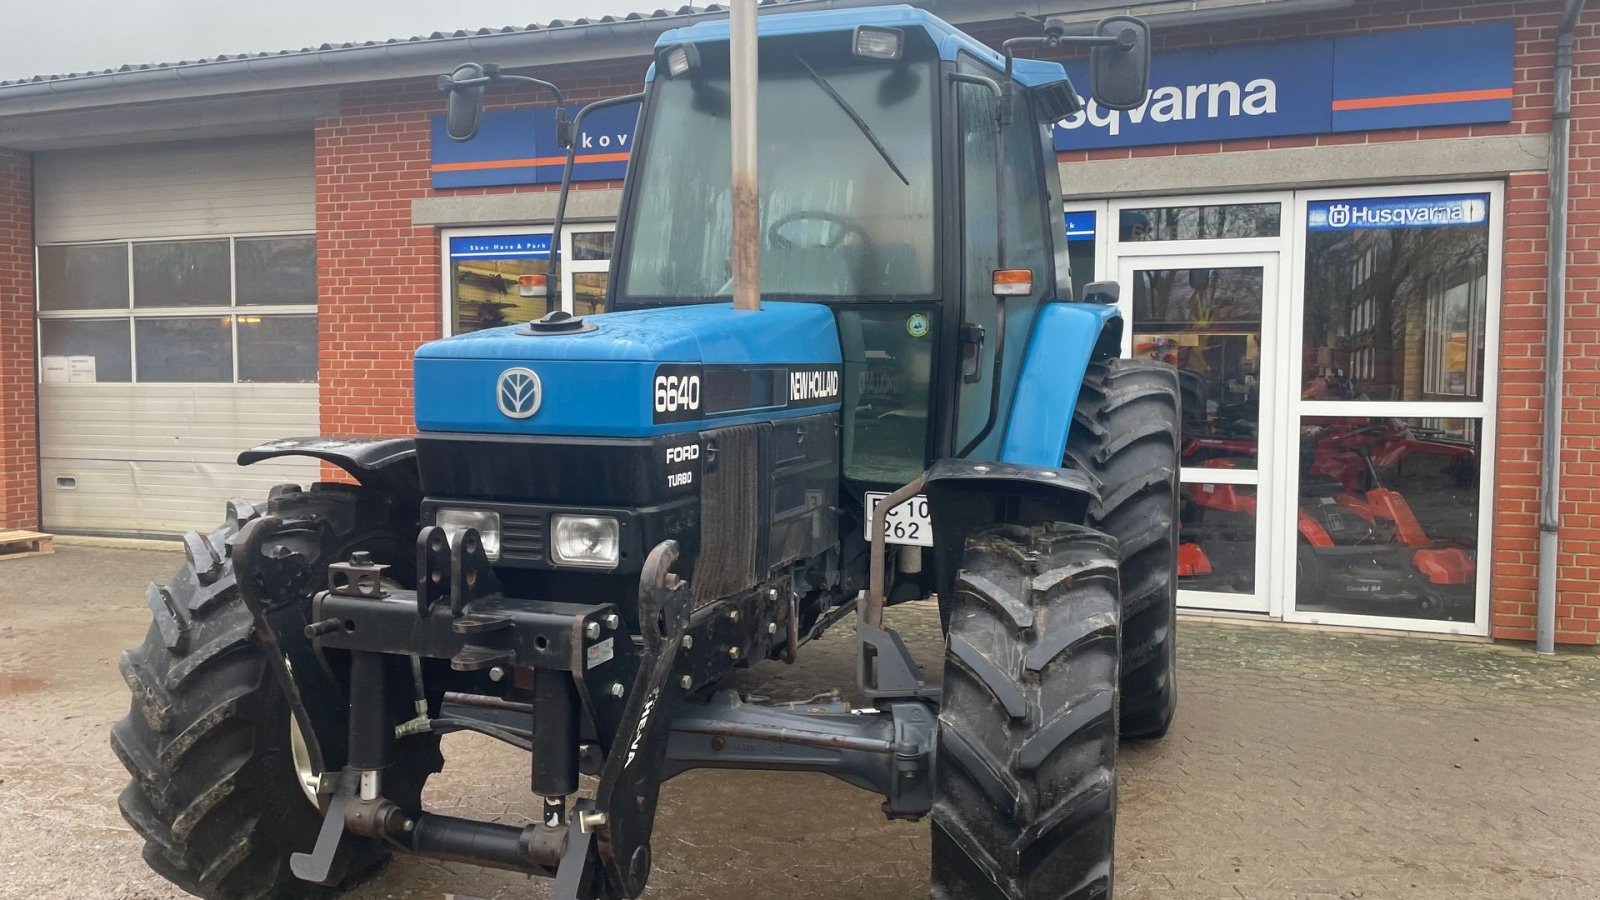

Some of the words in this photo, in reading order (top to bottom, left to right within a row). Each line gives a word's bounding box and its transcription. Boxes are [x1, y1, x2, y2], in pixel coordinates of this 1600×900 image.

[1052, 78, 1277, 136] sqvarna
[567, 132, 628, 149] kov
[1353, 206, 1462, 225] Husqvarna
[526, 242, 546, 250] Park
[655, 375, 700, 413] 6640
[666, 444, 699, 464] FORD
[667, 471, 692, 488] TURBO
[885, 520, 919, 539] 262
